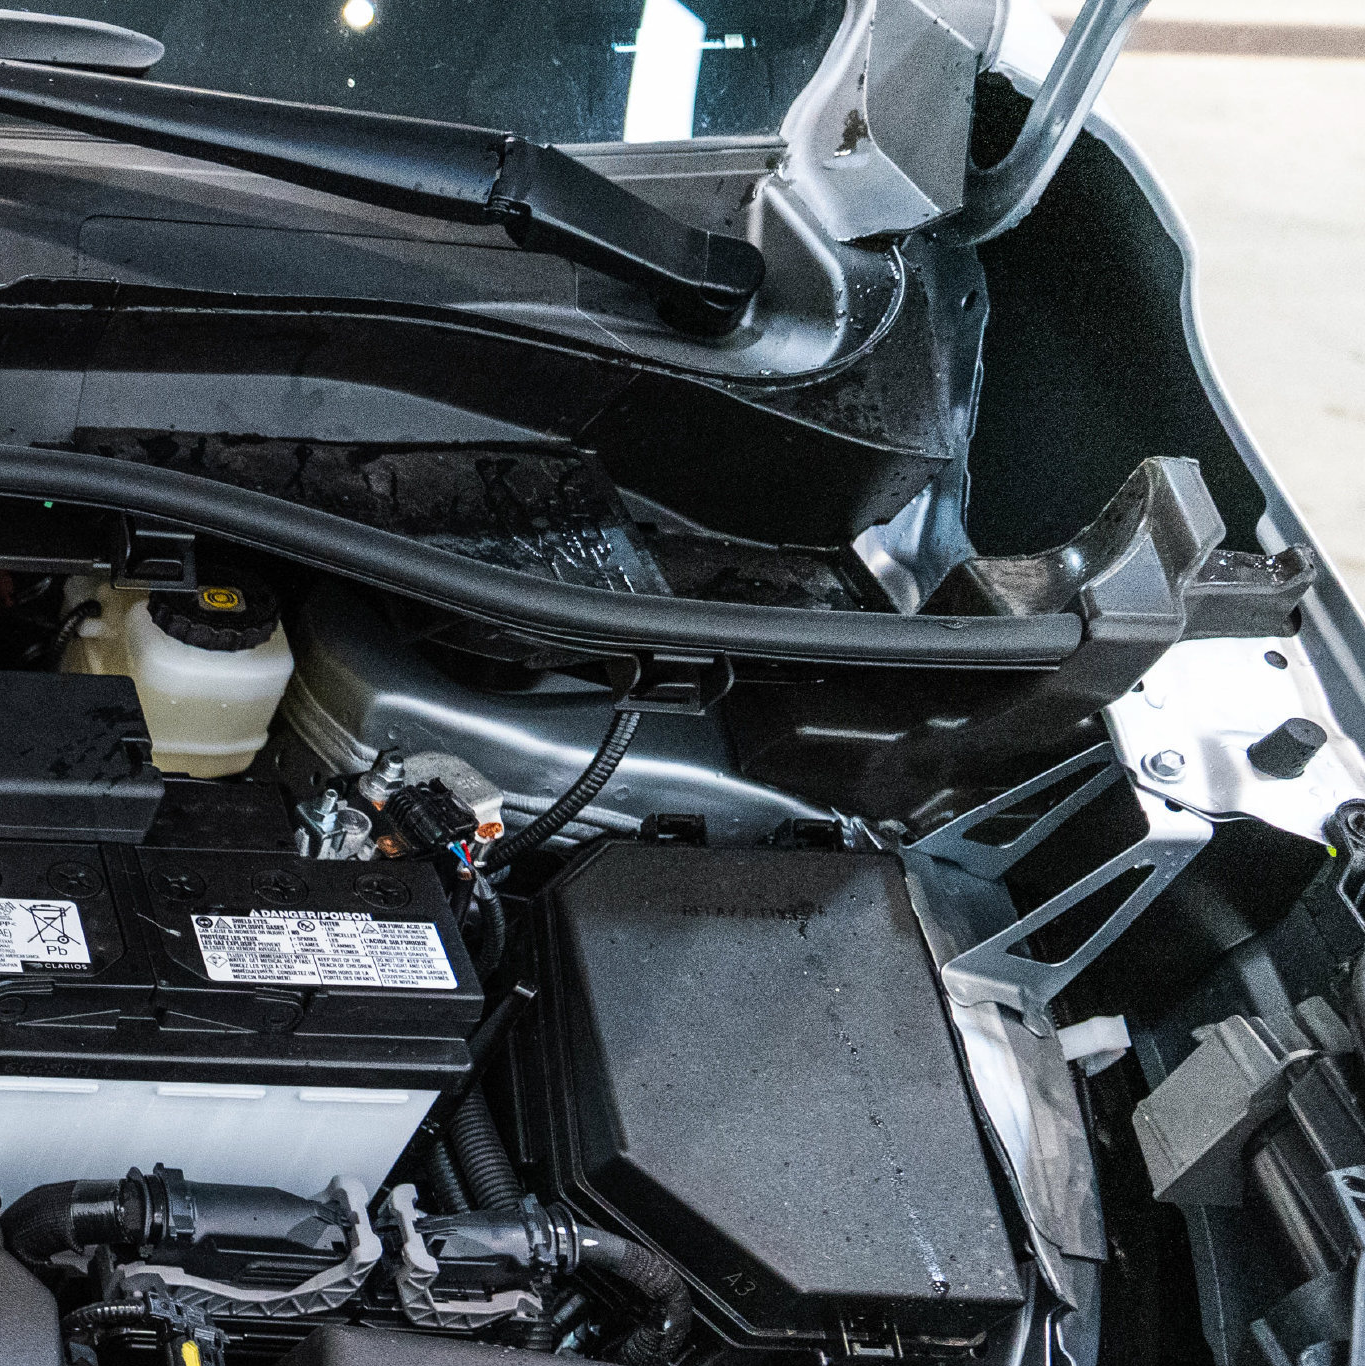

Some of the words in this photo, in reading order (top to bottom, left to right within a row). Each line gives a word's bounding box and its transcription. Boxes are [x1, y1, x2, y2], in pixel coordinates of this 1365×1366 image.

[260, 909, 372, 921] DANGER/POISON
[46, 945, 68, 956] Pb
[44, 962, 88, 970] CLARIOS
